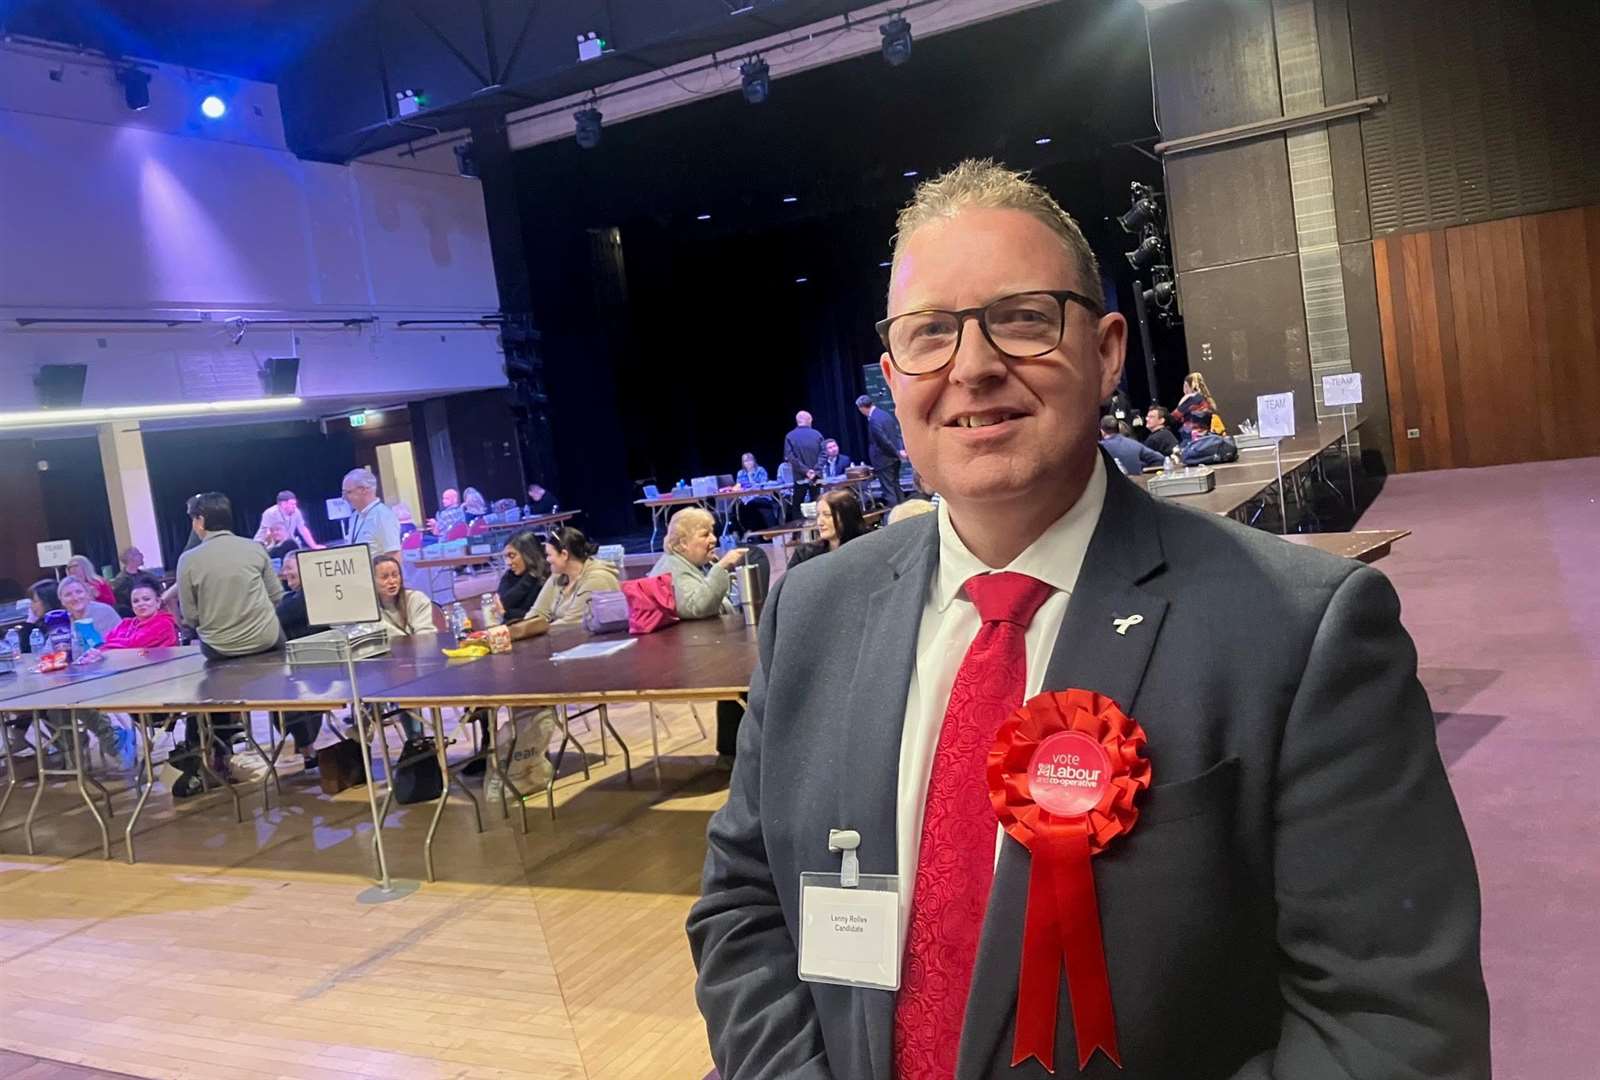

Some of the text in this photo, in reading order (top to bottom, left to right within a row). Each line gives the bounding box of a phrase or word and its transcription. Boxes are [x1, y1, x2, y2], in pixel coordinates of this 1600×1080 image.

[1264, 399, 1287, 410] TEAM
[314, 558, 355, 577] TEAM
[335, 584, 344, 601] 5
[1052, 753, 1080, 765] vote
[1050, 764, 1101, 781] Labour
[834, 924, 864, 933] Candidate
